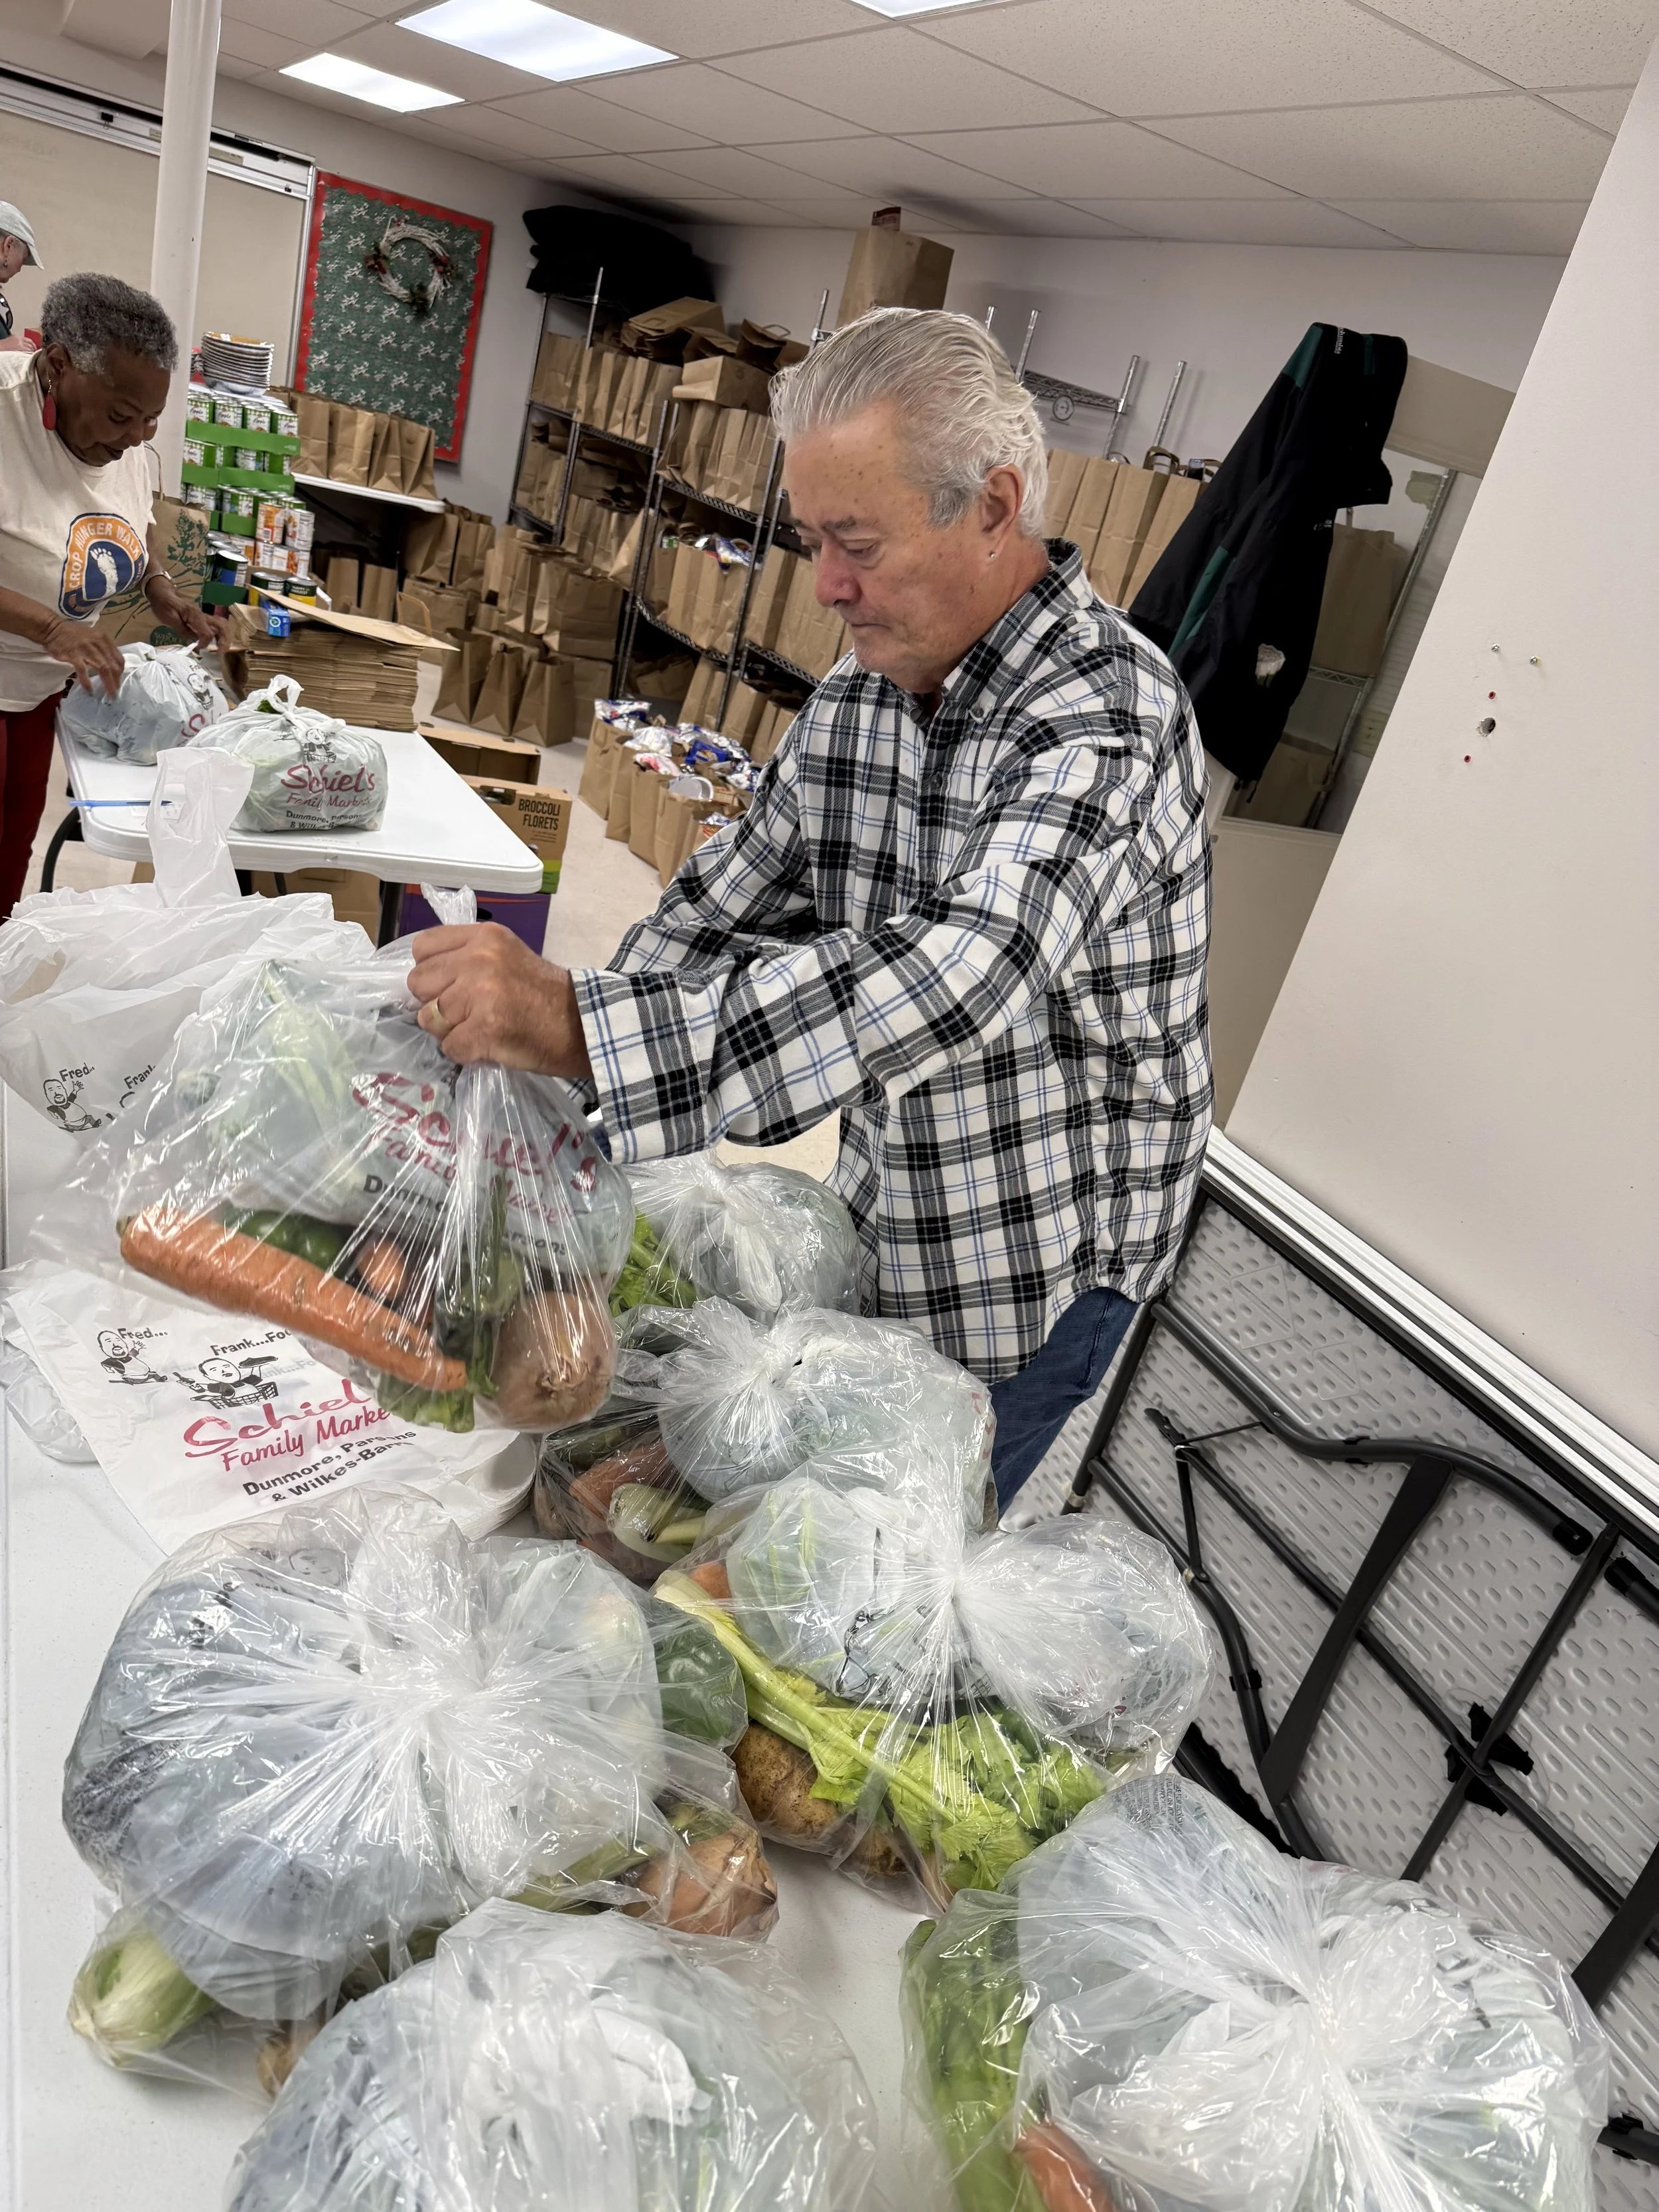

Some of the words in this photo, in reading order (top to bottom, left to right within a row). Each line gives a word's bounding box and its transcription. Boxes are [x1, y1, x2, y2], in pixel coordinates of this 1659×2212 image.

[74, 522, 113, 552] HUNGER
[117, 525, 140, 557] WALK
[69, 551, 83, 589] CROP
[518, 798, 561, 816] BROCCOLI
[523, 814, 559, 830] FLORETS
[183, 1378, 372, 1458] Schiel
[221, 1429, 304, 1471] Family
[317, 1406, 390, 1445] Marke
[242, 1453, 342, 1496] Dunmore,
[271, 1493, 287, 1502] &
